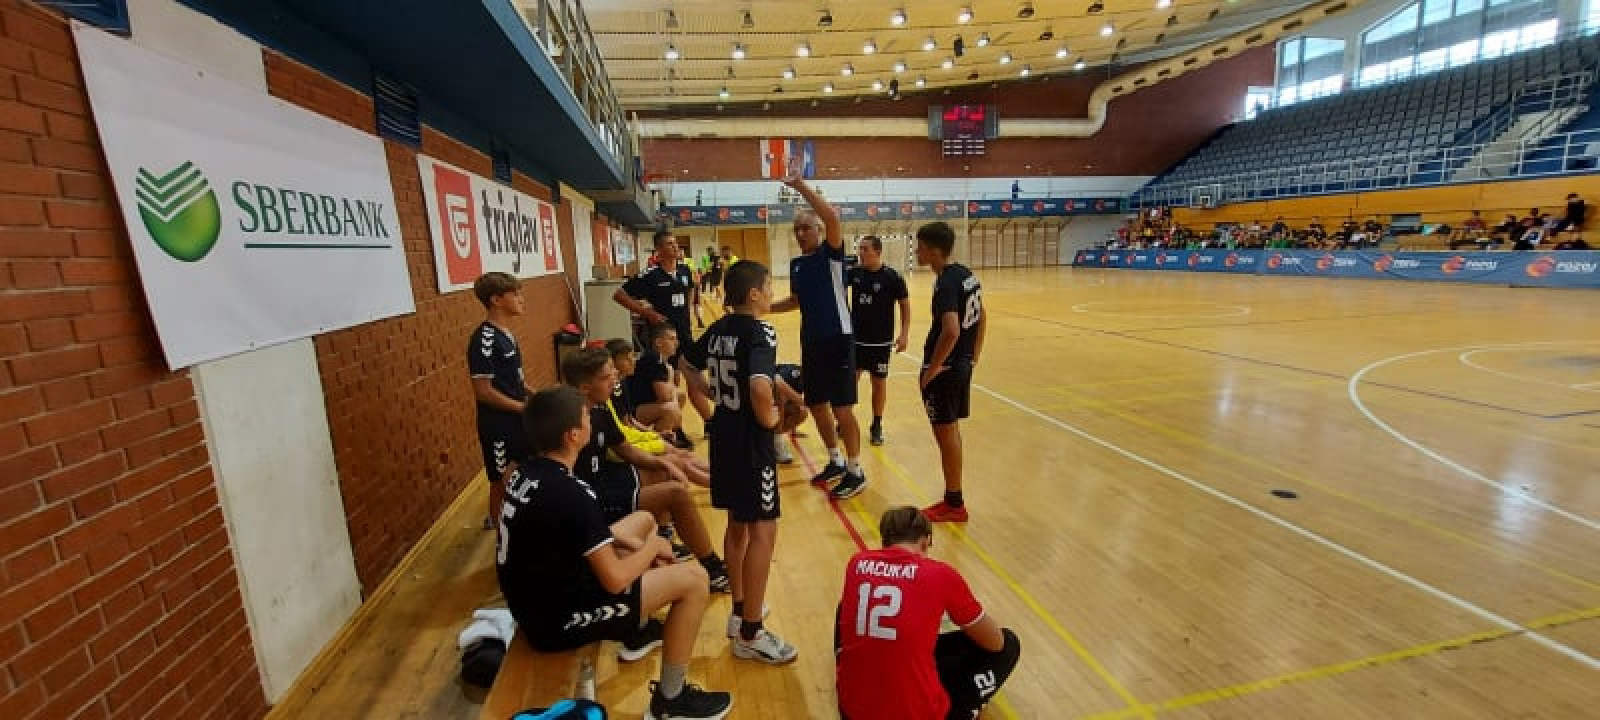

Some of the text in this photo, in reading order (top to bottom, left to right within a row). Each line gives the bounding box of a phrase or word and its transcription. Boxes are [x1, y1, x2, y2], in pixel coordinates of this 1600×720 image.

[232, 178, 390, 238] SBERBANK
[482, 189, 538, 274] triglav
[856, 582, 903, 640] 12
